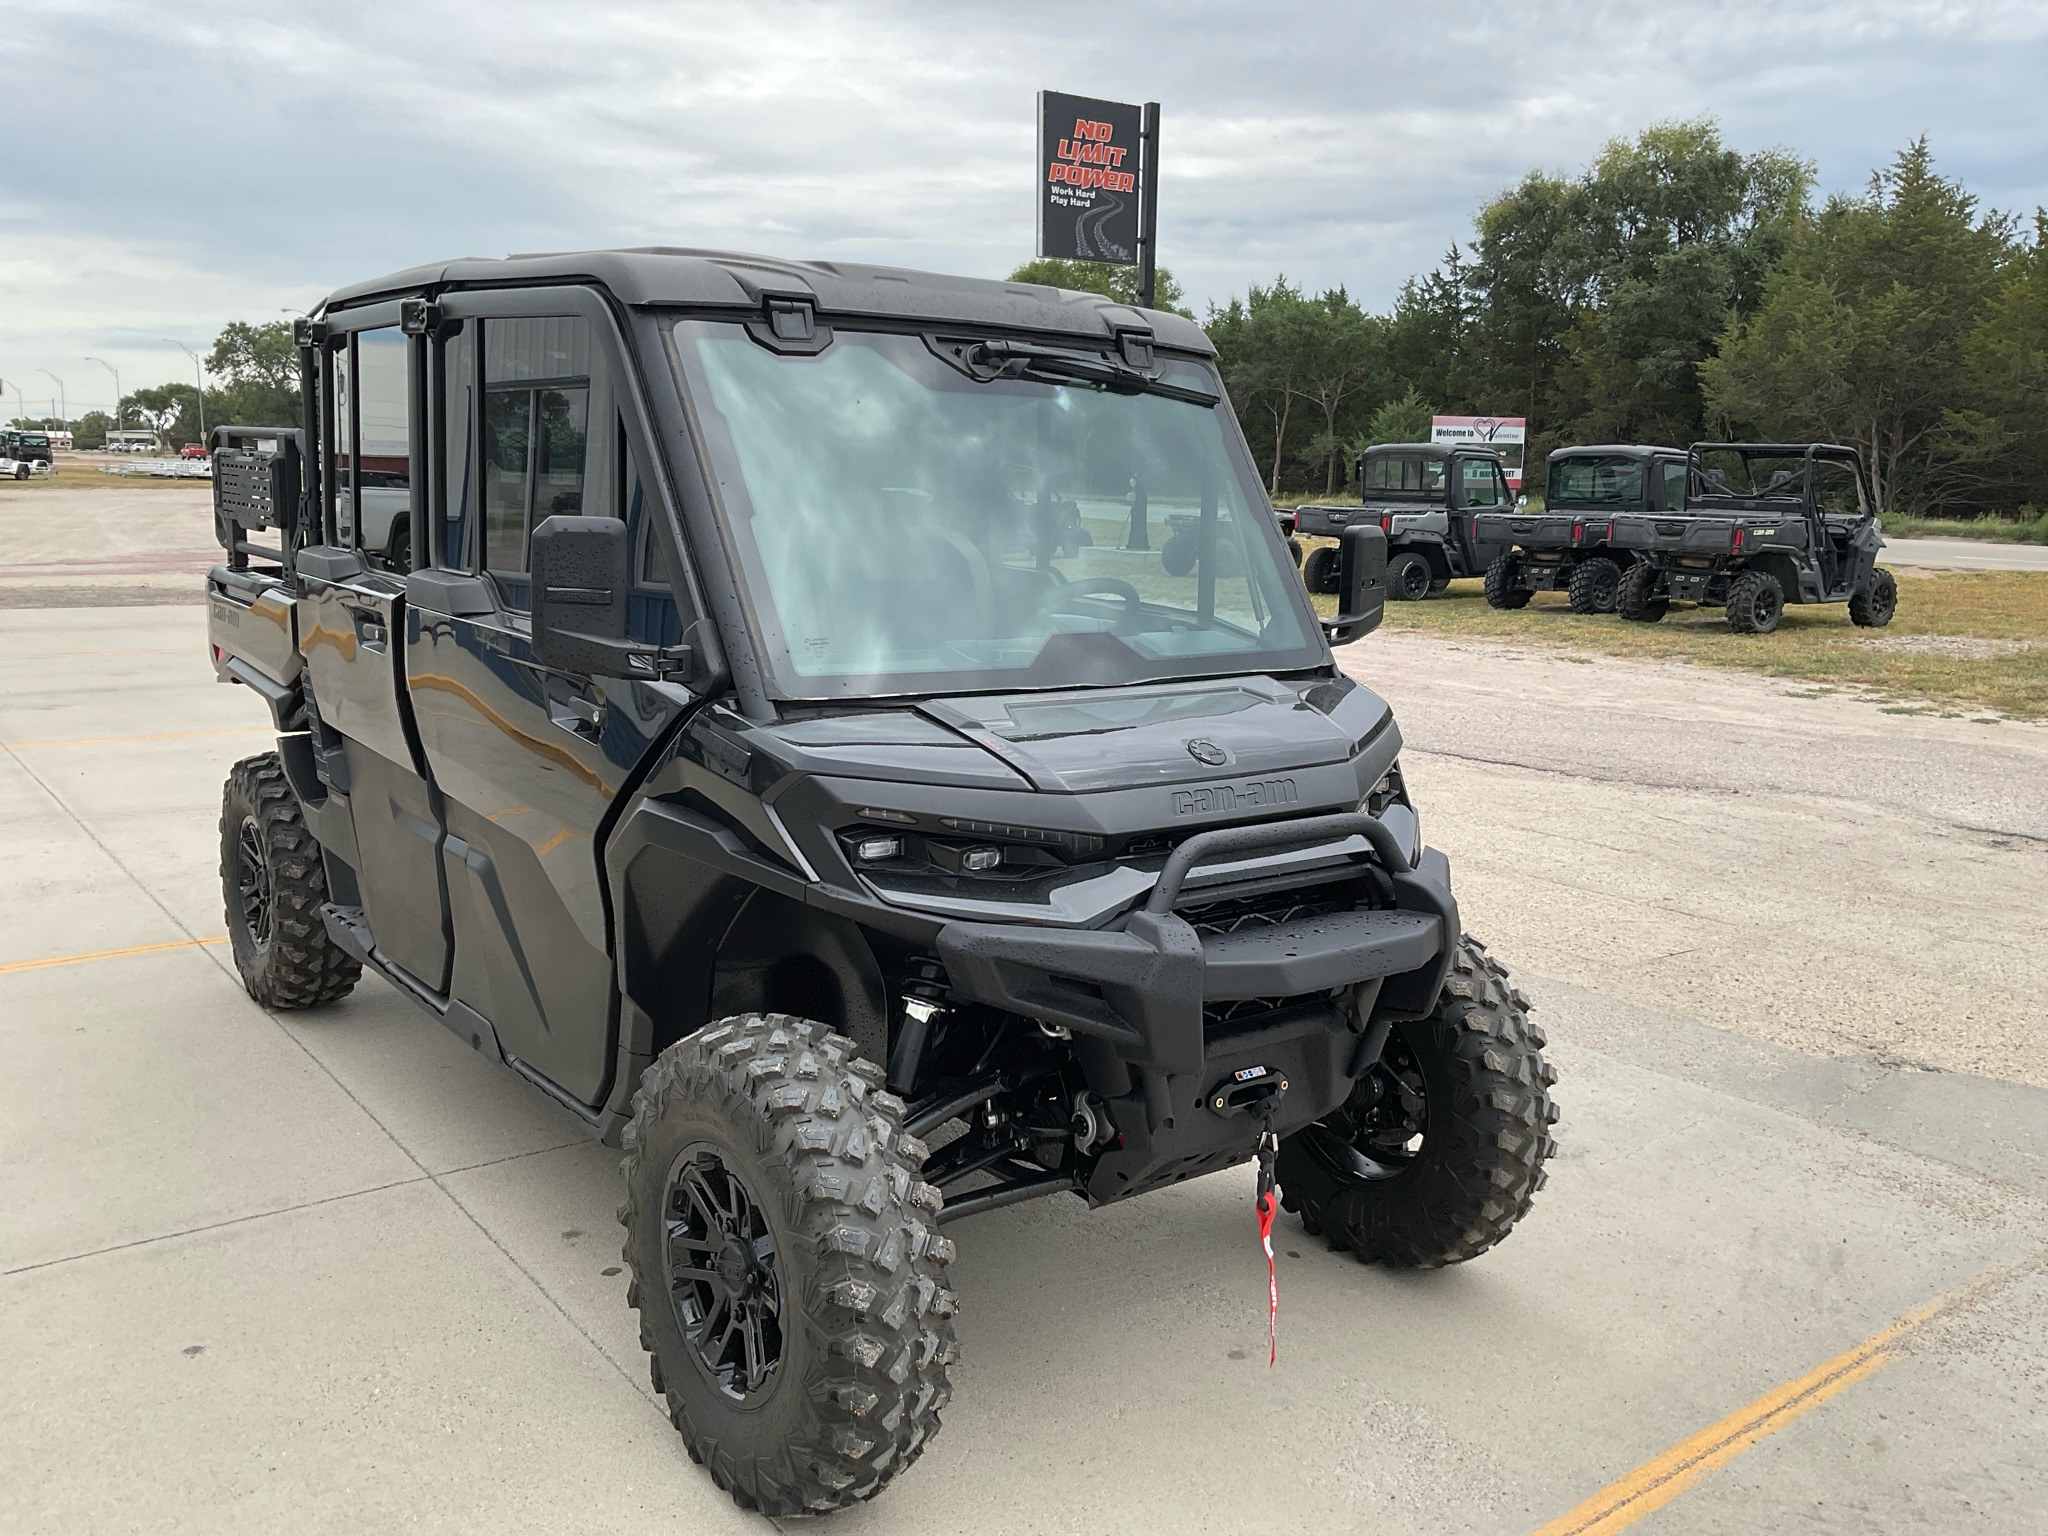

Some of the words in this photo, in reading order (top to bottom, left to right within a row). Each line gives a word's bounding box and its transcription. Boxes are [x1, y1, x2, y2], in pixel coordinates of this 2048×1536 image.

[1074, 118, 1113, 143] NO
[1057, 138, 1127, 166] LIMIT
[1050, 194, 1069, 207] Play
[1070, 197, 1091, 208] Hard
[1051, 185, 1074, 197] Work
[1075, 188, 1096, 199] Hard
[1435, 428, 1467, 437] Welcome
[1467, 429, 1475, 437] to
[1488, 421, 1520, 442] Valentine
[213, 603, 240, 629] can-am
[1171, 778, 1299, 818] can-am
